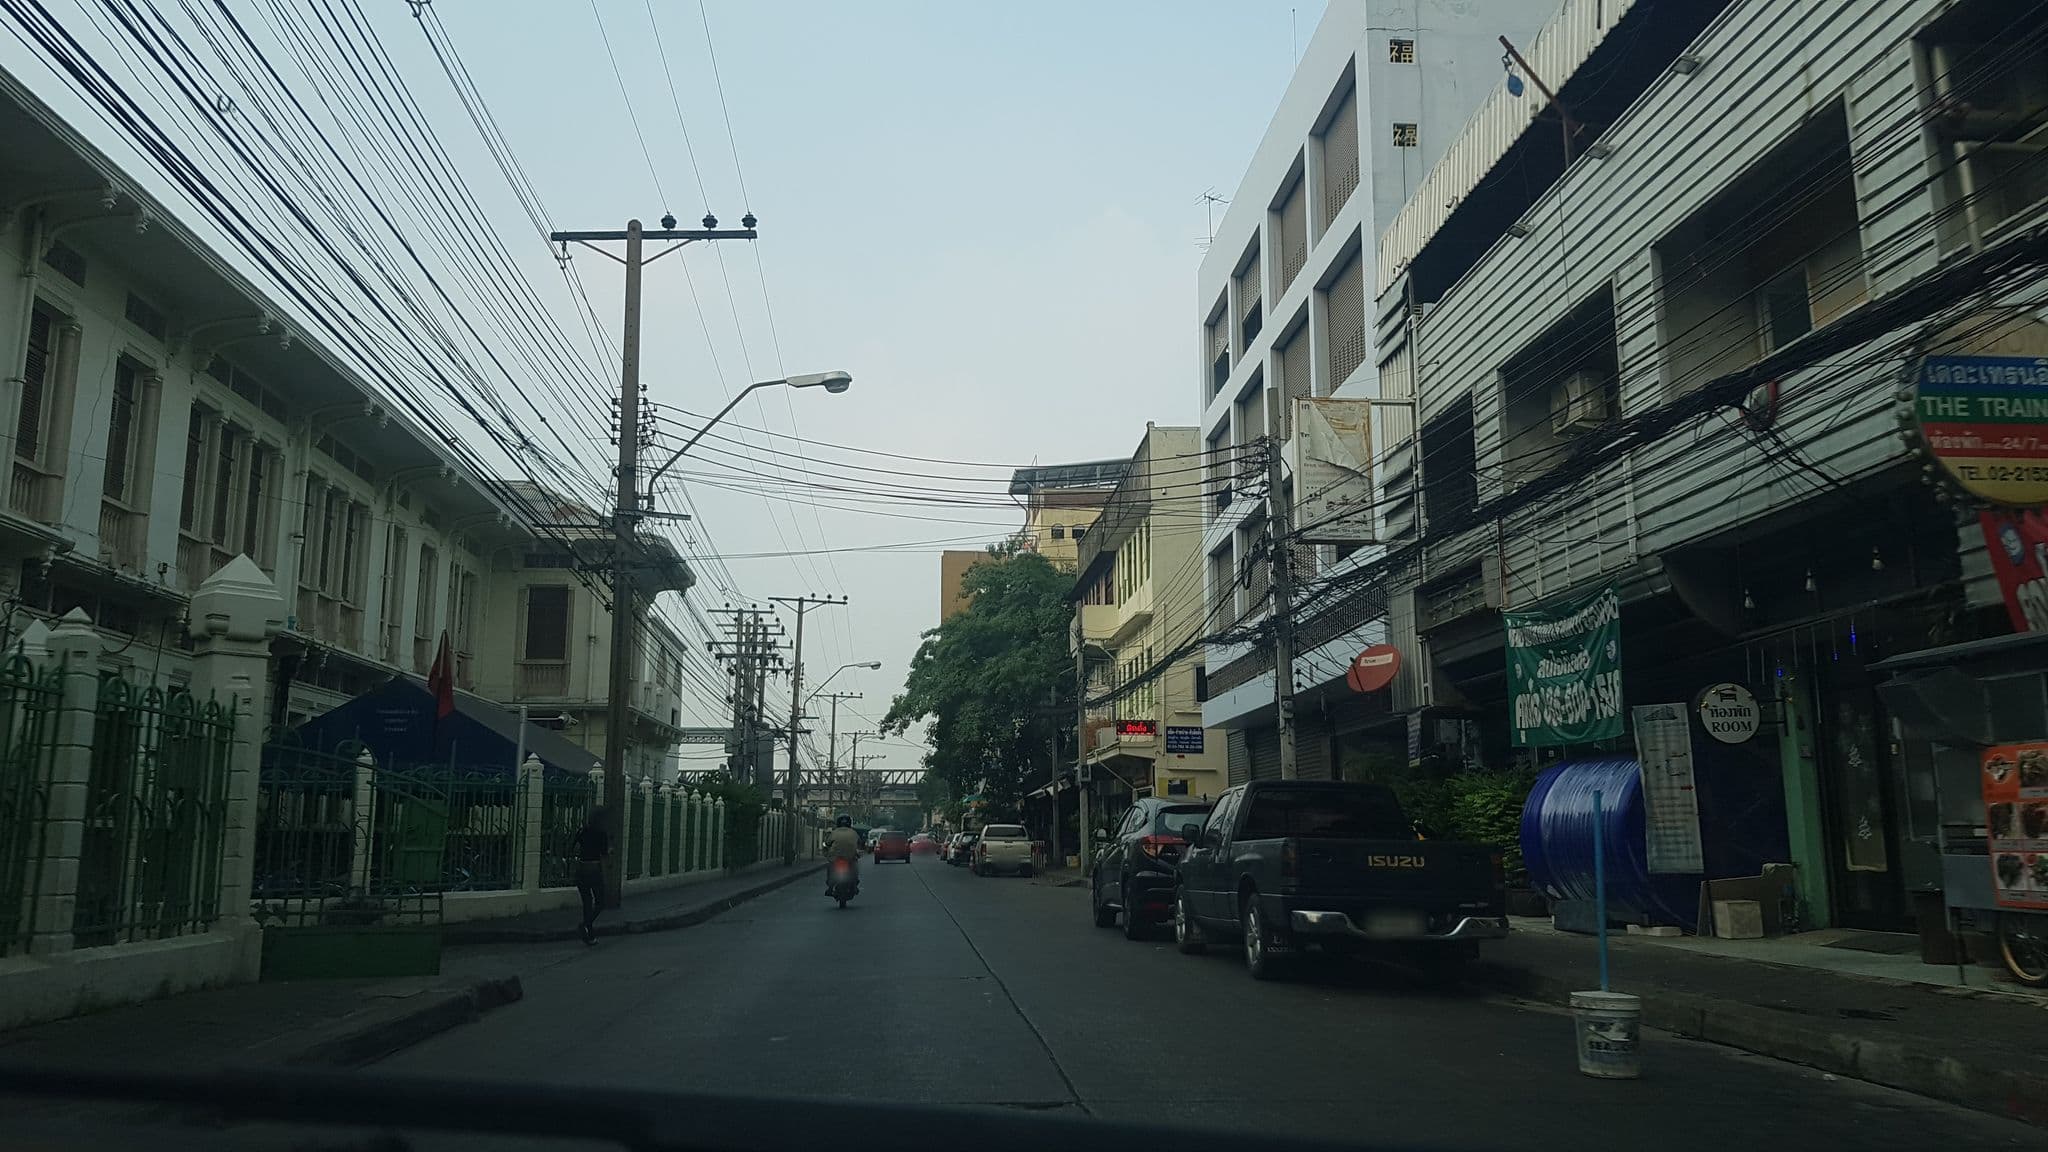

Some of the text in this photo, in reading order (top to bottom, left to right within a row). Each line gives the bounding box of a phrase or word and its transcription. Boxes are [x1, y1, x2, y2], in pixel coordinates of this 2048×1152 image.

[1390, 39, 1414, 64] 福
[1393, 122, 1417, 147] 福
[1920, 396, 2048, 418] THE TRAIN
[1710, 704, 1752, 718] ห้องพัก
[1712, 721, 1752, 733] ROOM
[1367, 855, 1425, 867] ISUZU
